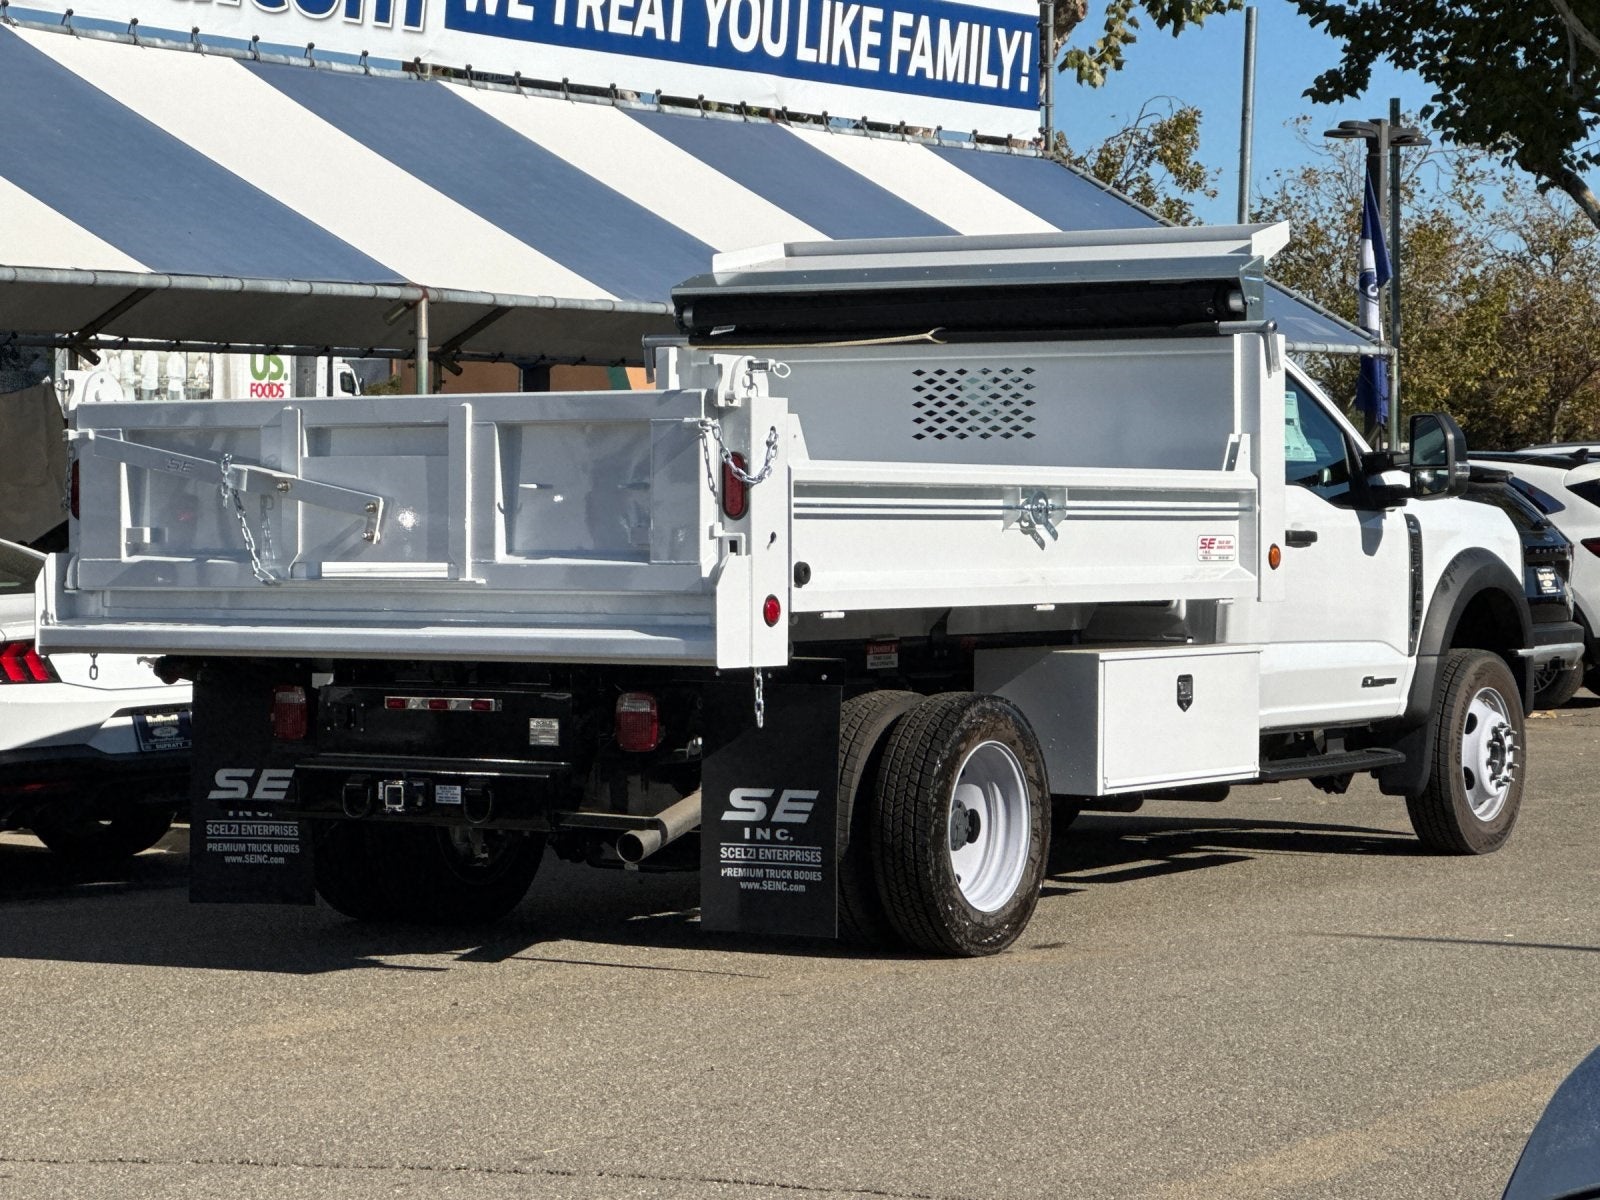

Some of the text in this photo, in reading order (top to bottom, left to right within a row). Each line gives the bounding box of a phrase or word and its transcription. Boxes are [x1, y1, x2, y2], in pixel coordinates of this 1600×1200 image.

[705, 0, 789, 57] YOU
[797, 0, 883, 72] LIKE
[889, 10, 1032, 92] FAMILY!
[250, 382, 285, 398] FOODS
[1199, 538, 1217, 549] SE
[207, 768, 295, 800] SE
[720, 787, 820, 823] SE
[206, 824, 299, 836] SCELZI ENTERPRISES
[744, 827, 794, 841] INC.
[206, 842, 300, 853] PREMIUM TRUCK BODIES
[720, 847, 822, 862] SCELZI ENTERPRISES
[224, 854, 285, 864] www.SEINC.com
[721, 867, 822, 881] PREMIUM TRUCK BODIES
[740, 881, 806, 892] www.SEINC.com
